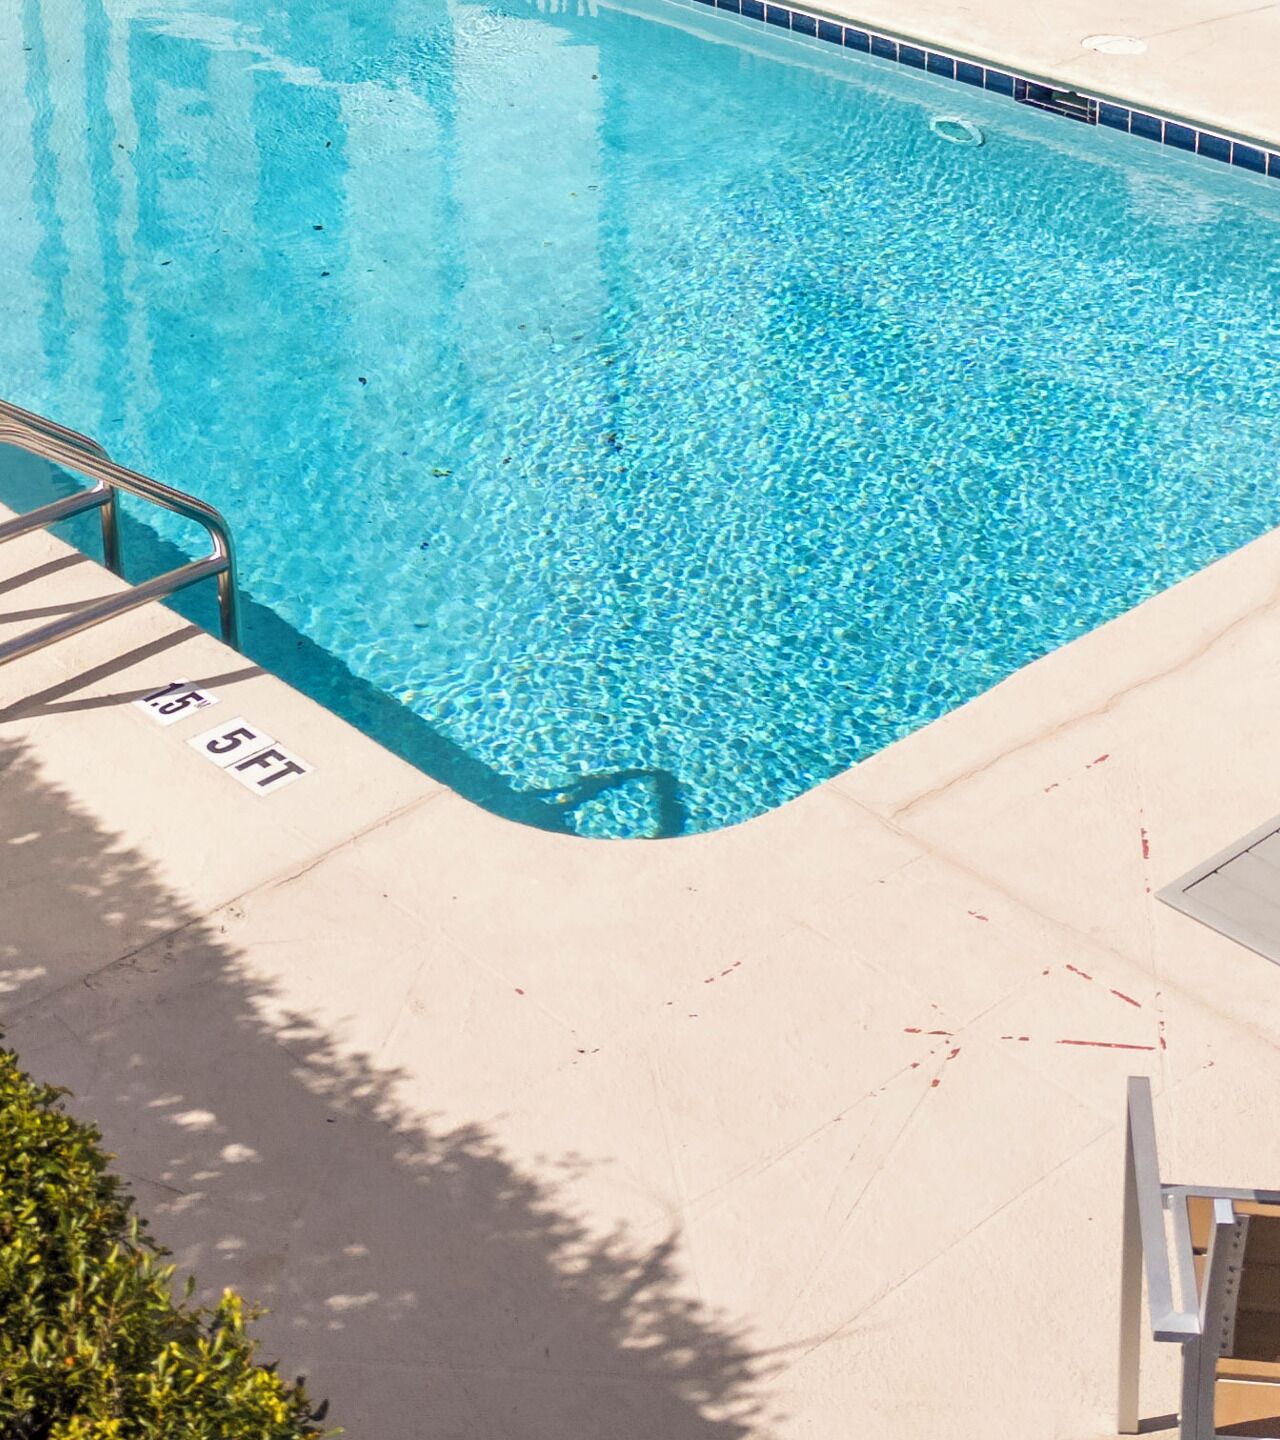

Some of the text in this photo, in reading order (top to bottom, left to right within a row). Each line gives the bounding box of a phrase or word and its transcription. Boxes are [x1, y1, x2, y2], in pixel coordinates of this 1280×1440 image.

[143, 682, 205, 715] 1.5
[206, 727, 307, 787] 5 FT
